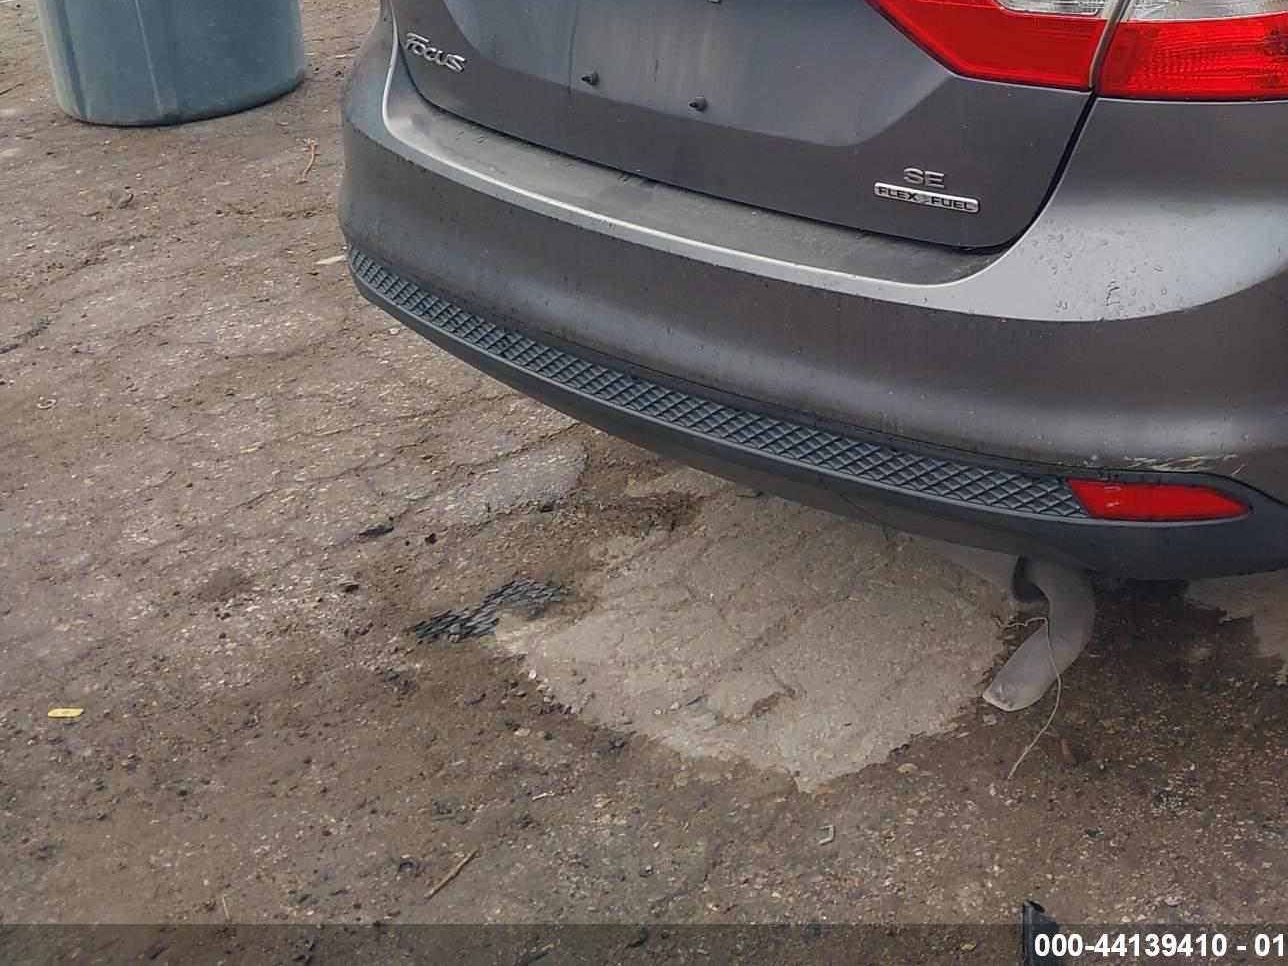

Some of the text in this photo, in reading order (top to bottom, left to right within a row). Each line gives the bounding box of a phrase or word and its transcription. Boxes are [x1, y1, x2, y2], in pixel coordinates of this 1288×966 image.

[902, 167, 945, 189] SE
[878, 186, 975, 212] FLEX FUEL
